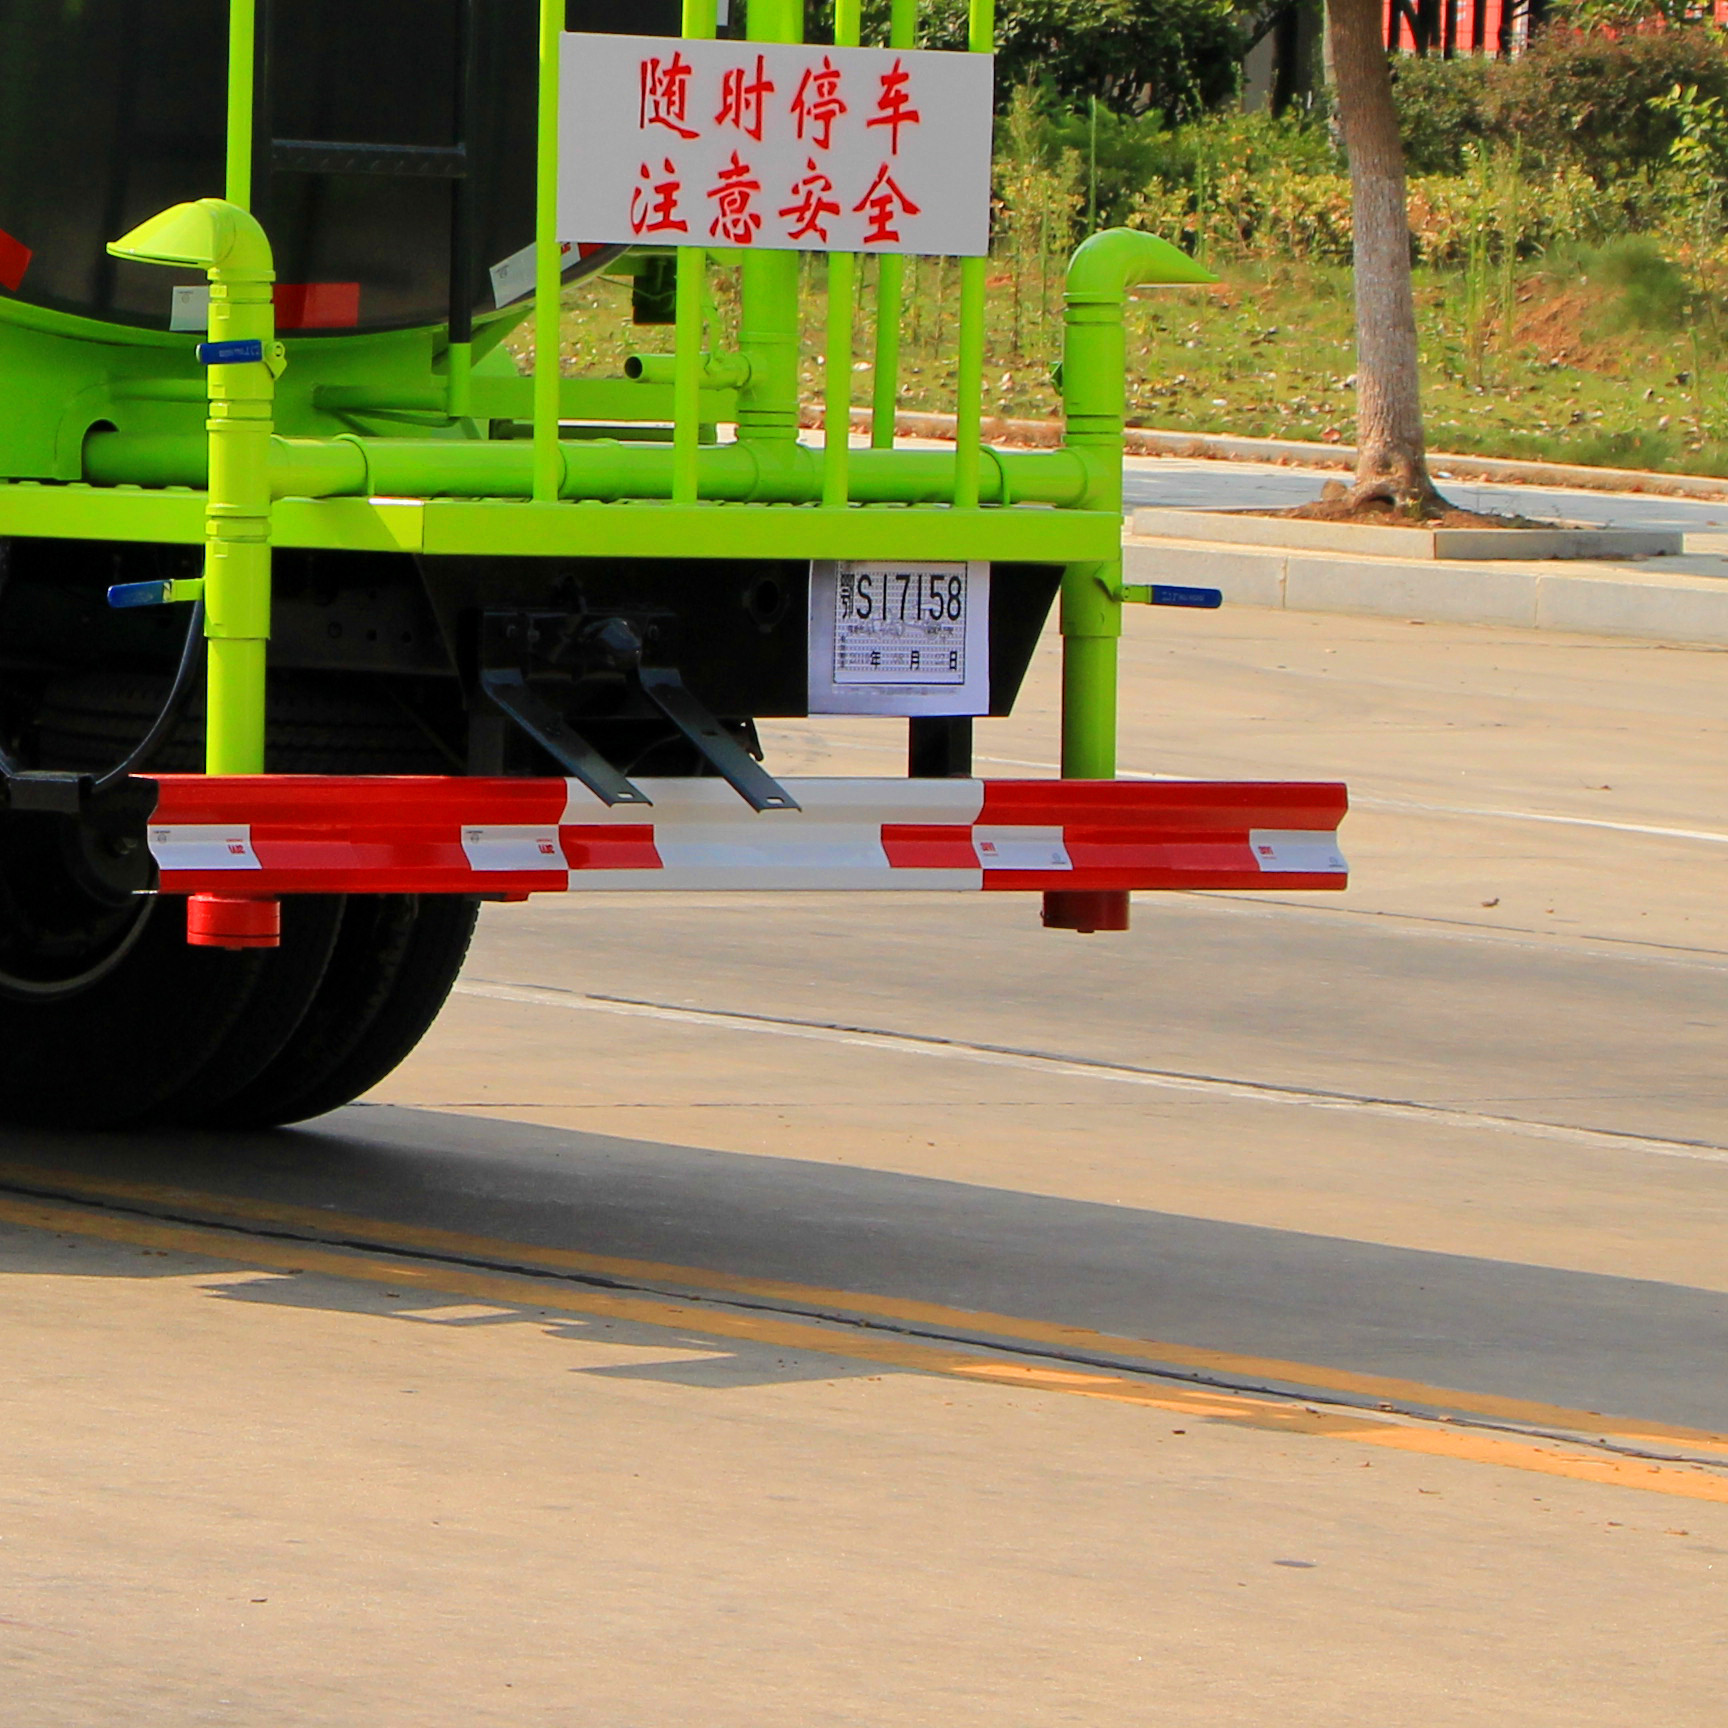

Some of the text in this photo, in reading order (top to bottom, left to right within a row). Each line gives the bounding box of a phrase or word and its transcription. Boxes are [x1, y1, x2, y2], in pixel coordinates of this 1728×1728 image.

[639, 51, 921, 155] 随时停车
[630, 150, 921, 244] 注意安全
